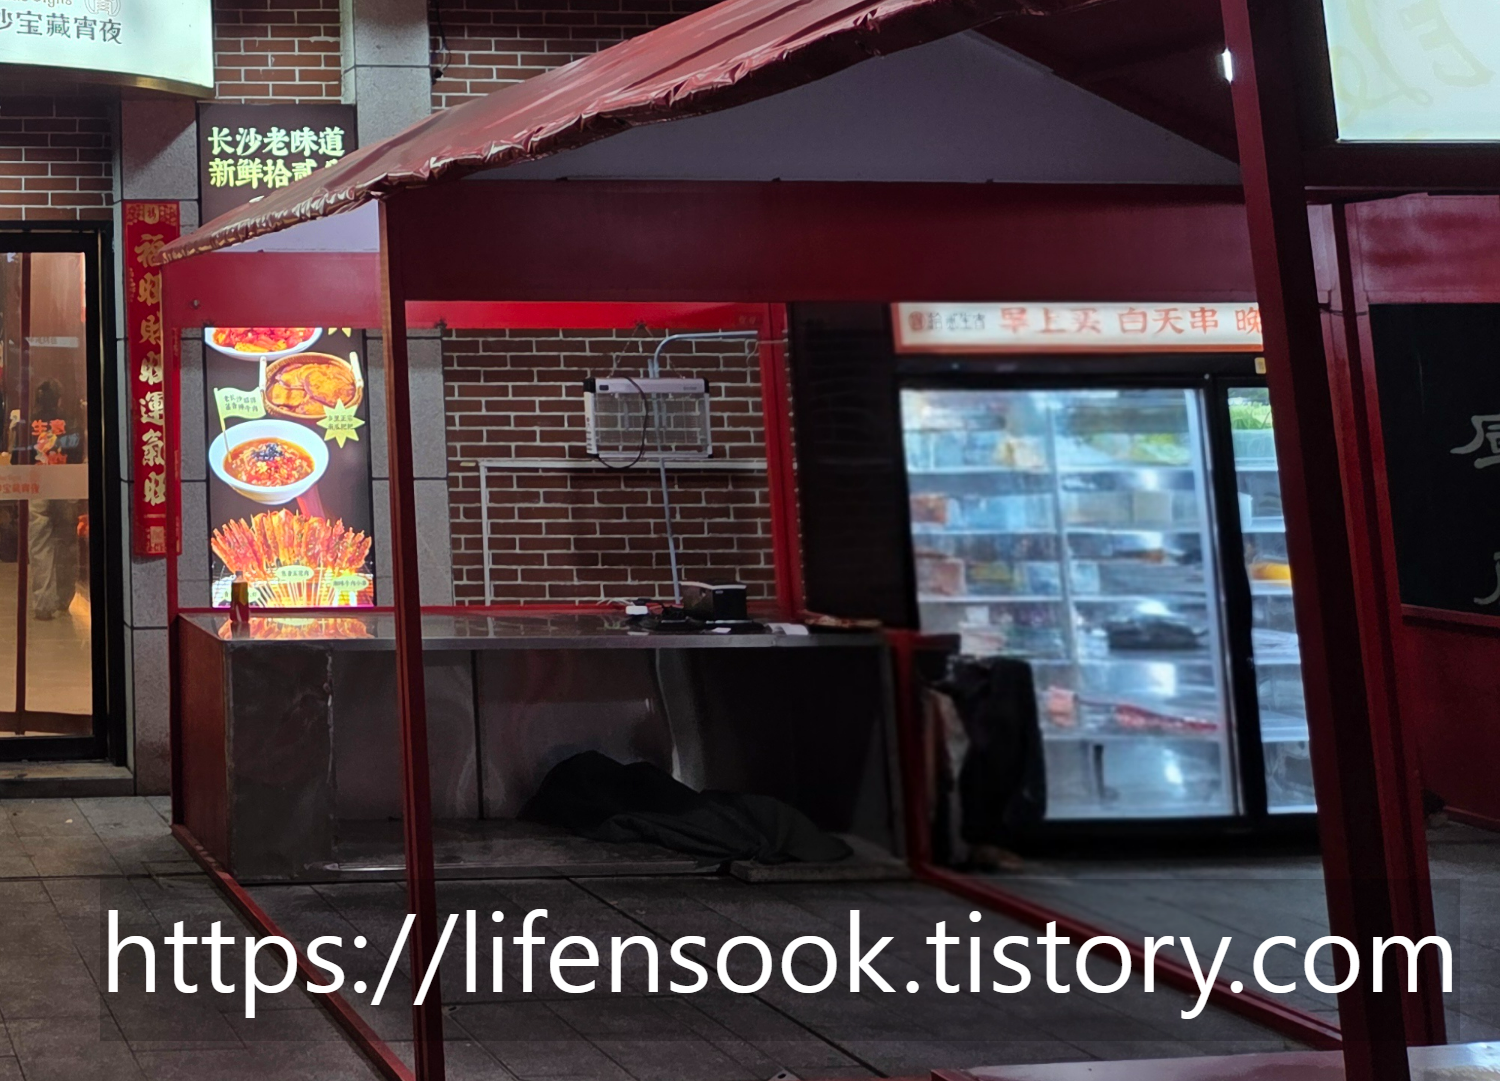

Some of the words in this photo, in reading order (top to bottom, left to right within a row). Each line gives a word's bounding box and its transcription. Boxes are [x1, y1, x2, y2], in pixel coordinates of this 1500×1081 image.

[207, 126, 346, 157] 长沙老味道
[208, 157, 339, 189] 新鲜拾贰
[1000, 307, 1102, 334] 早上买
[1118, 306, 1218, 335] 白天串
